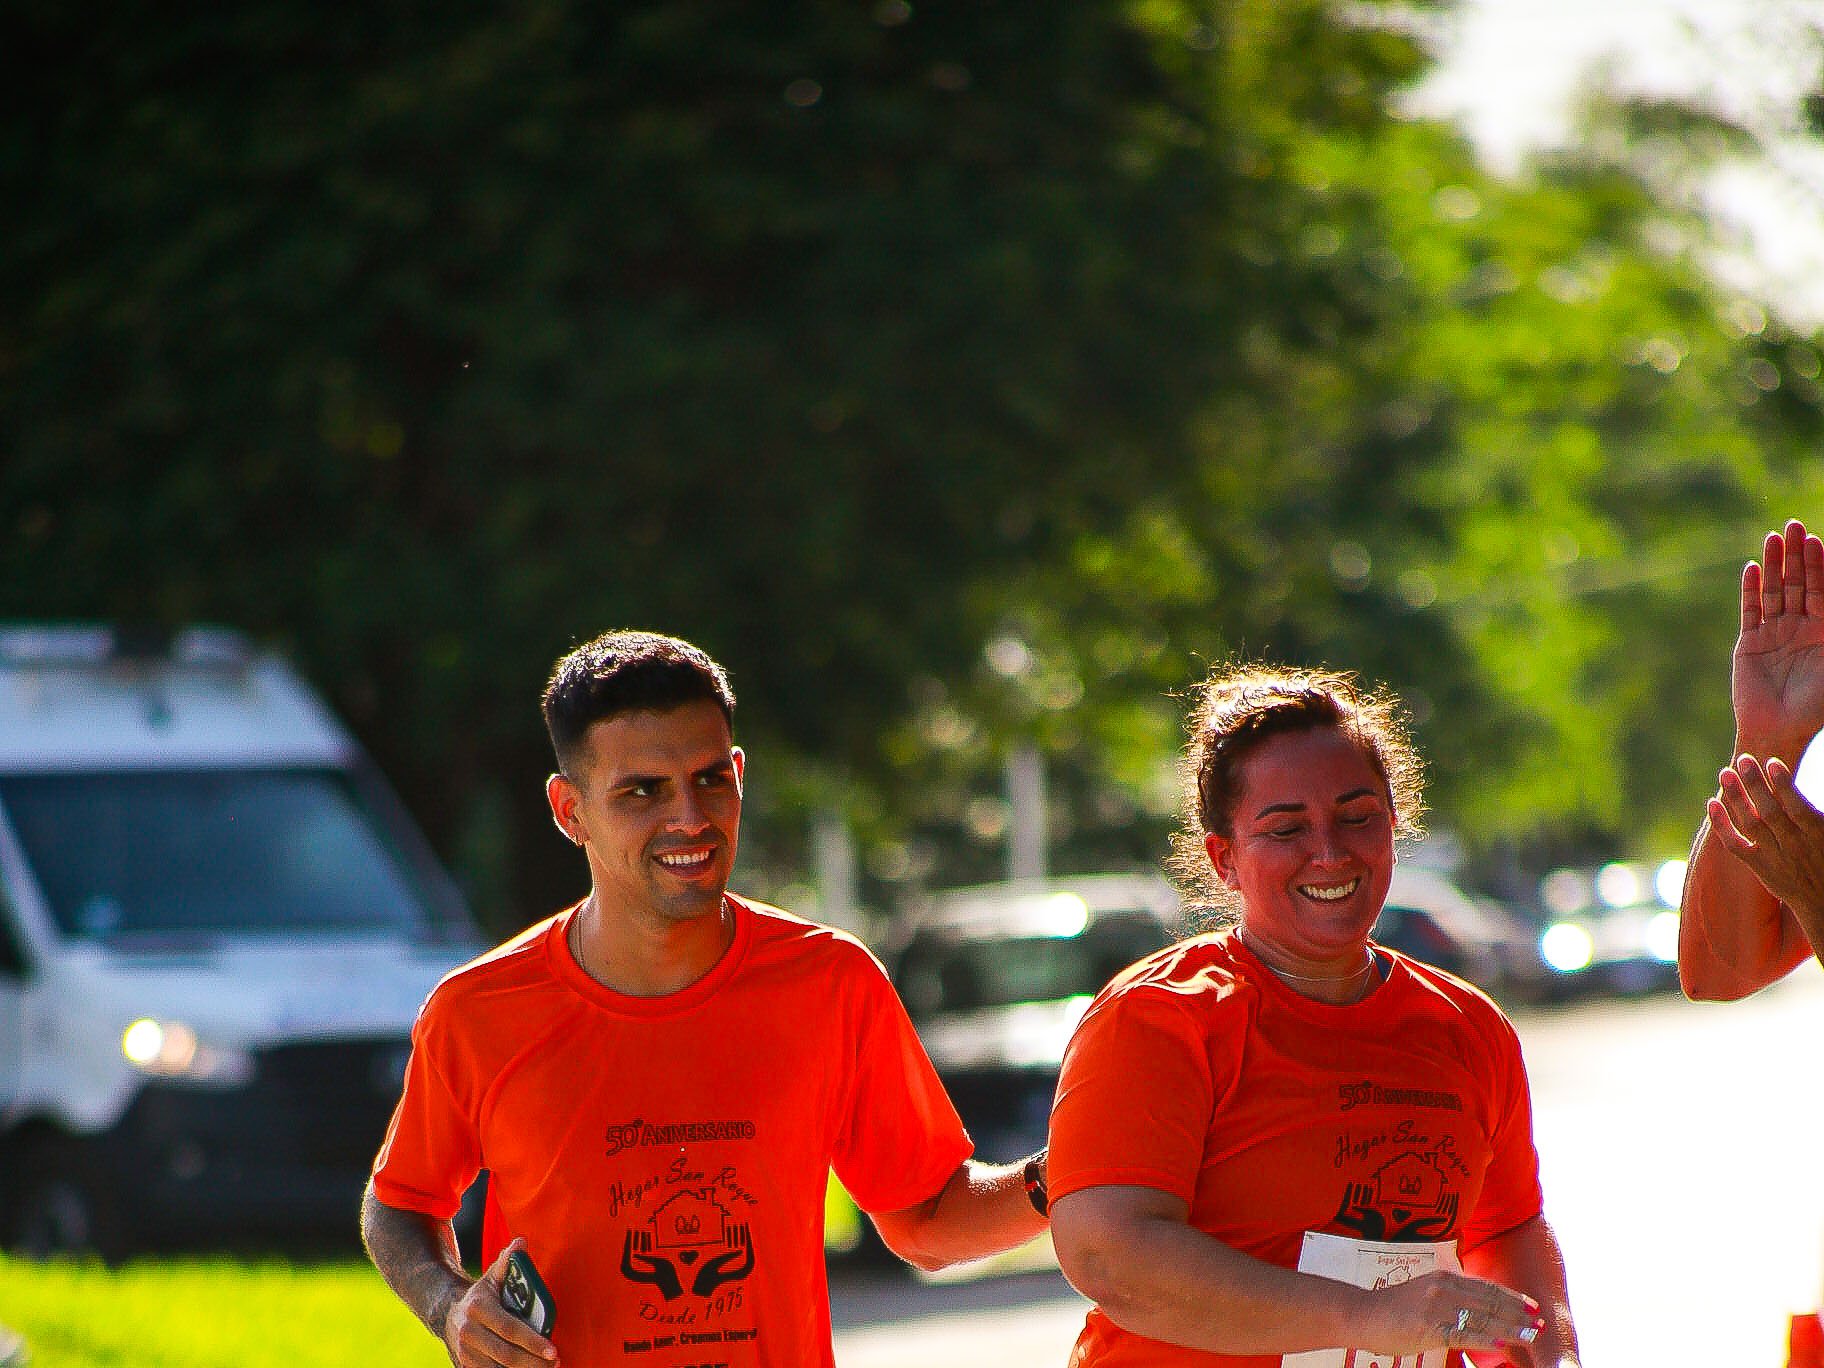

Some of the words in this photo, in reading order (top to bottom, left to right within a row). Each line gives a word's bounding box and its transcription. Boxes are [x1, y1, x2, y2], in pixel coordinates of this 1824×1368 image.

[1334, 1133, 1387, 1170] Hogar
[1392, 1120, 1431, 1146] San
[607, 1175, 660, 1218] Hogar
[665, 1157, 705, 1185] San
[711, 1166, 760, 1207] Roque
[639, 1300, 698, 1326] Desde
[705, 1286, 744, 1322] 1975
